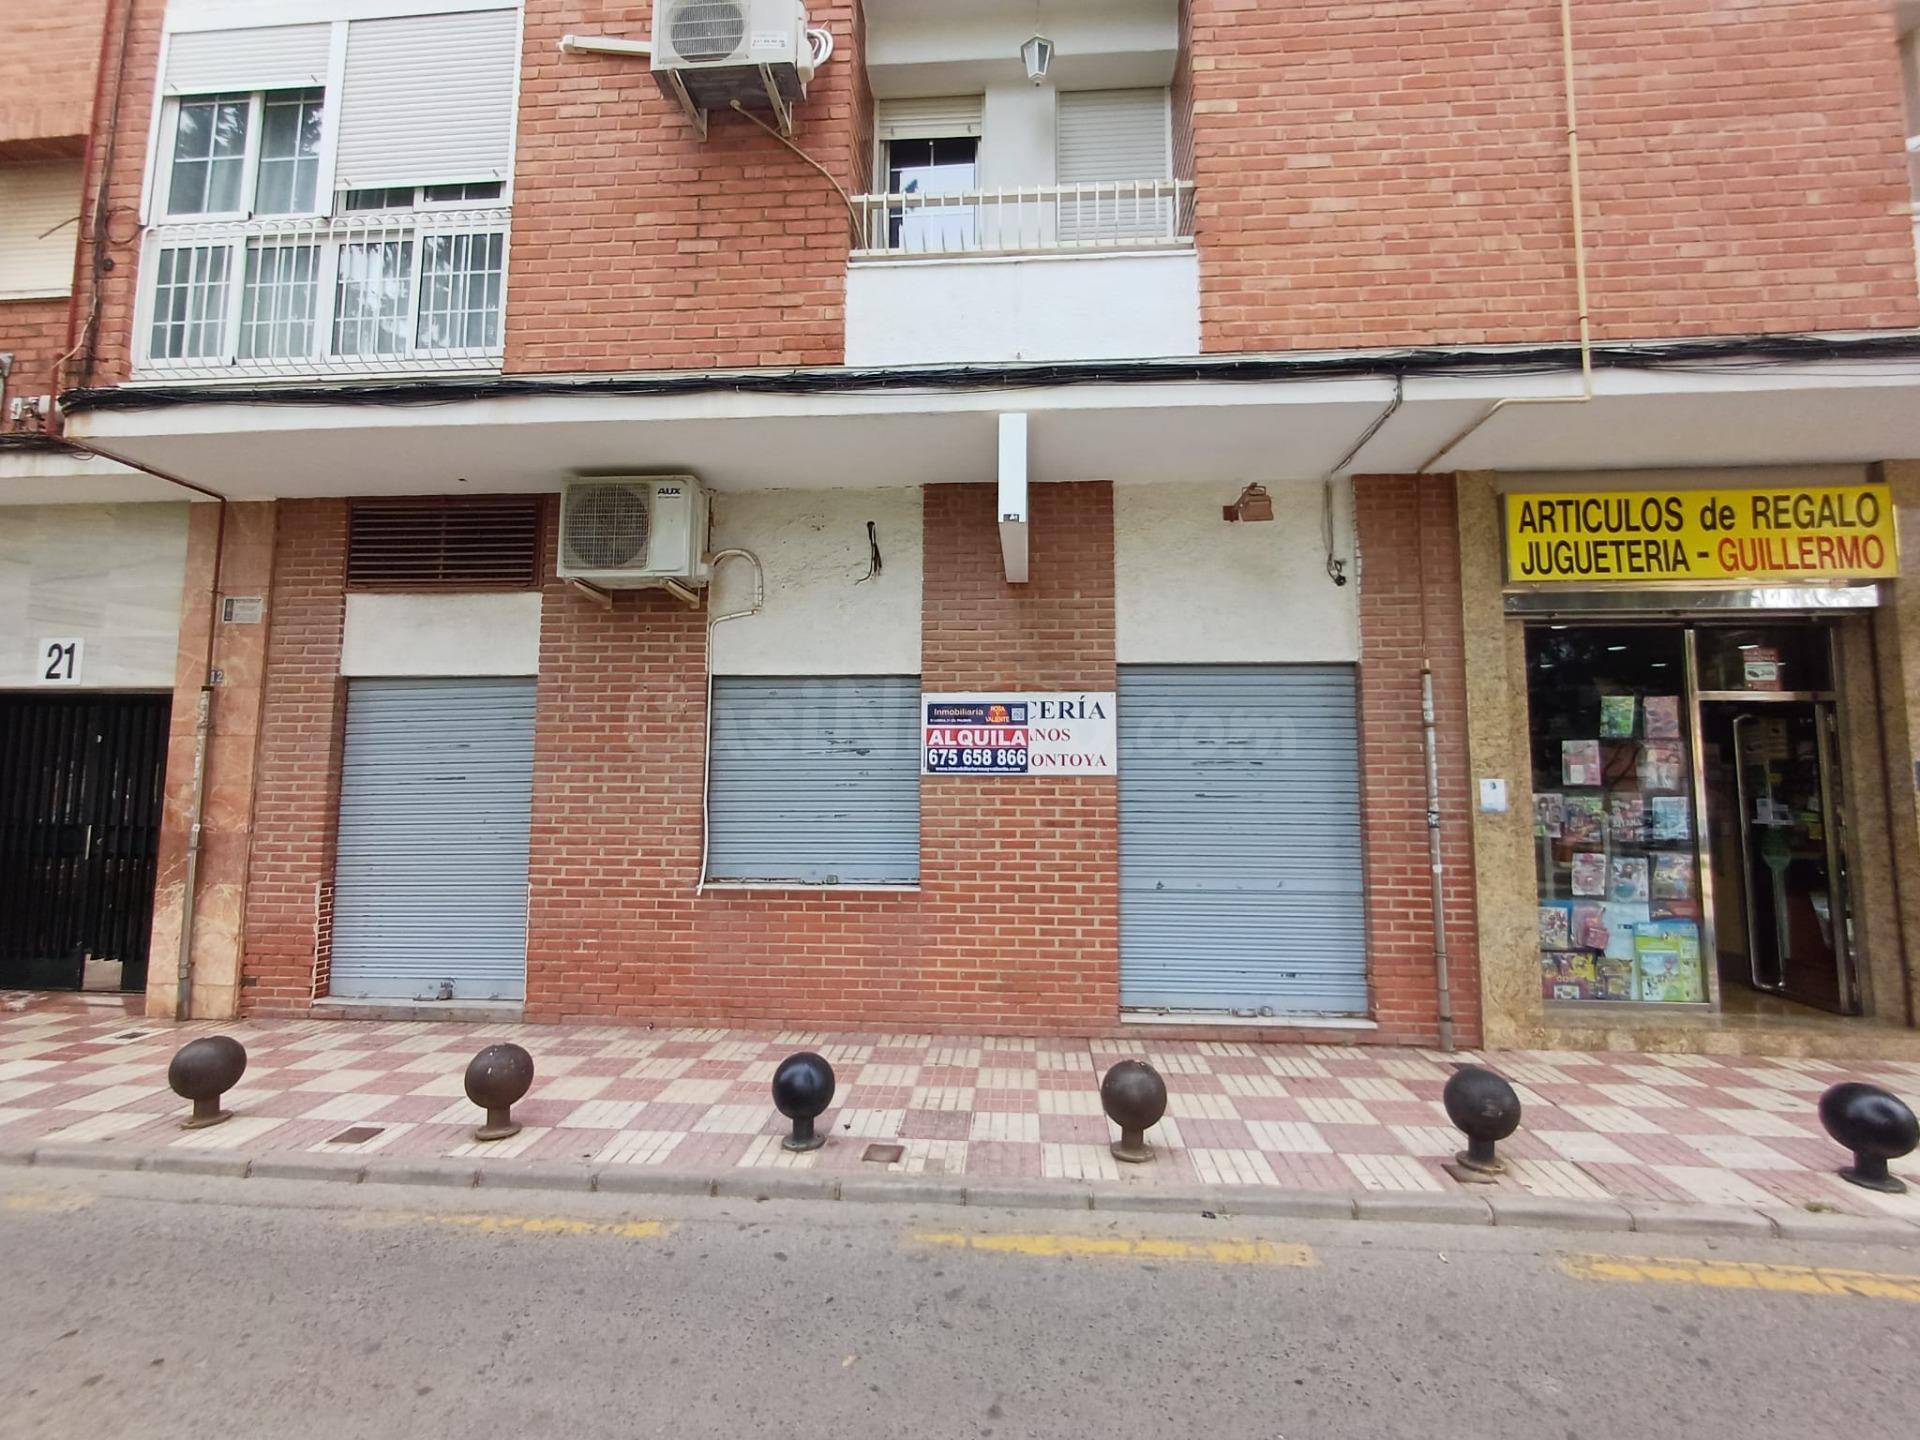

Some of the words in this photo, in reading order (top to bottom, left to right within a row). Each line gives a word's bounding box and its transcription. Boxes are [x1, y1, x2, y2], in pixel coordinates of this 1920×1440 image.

[657, 487, 681, 495] AUX
[1518, 496, 1684, 535] ARTICULOS
[1700, 496, 1736, 532] de
[1751, 491, 1880, 530] REGALO
[1520, 538, 1691, 576] JUGUETERIA
[1717, 533, 1885, 573] GUILLERMO
[45, 642, 76, 680] 21
[933, 707, 984, 717] Inmobiliaria
[928, 729, 1027, 746] ALQUILA
[1030, 728, 1071, 742] NOS
[928, 748, 958, 766] 675
[962, 748, 992, 766] 658
[996, 748, 1027, 766] 866
[1031, 752, 1108, 767] ONTOYA
